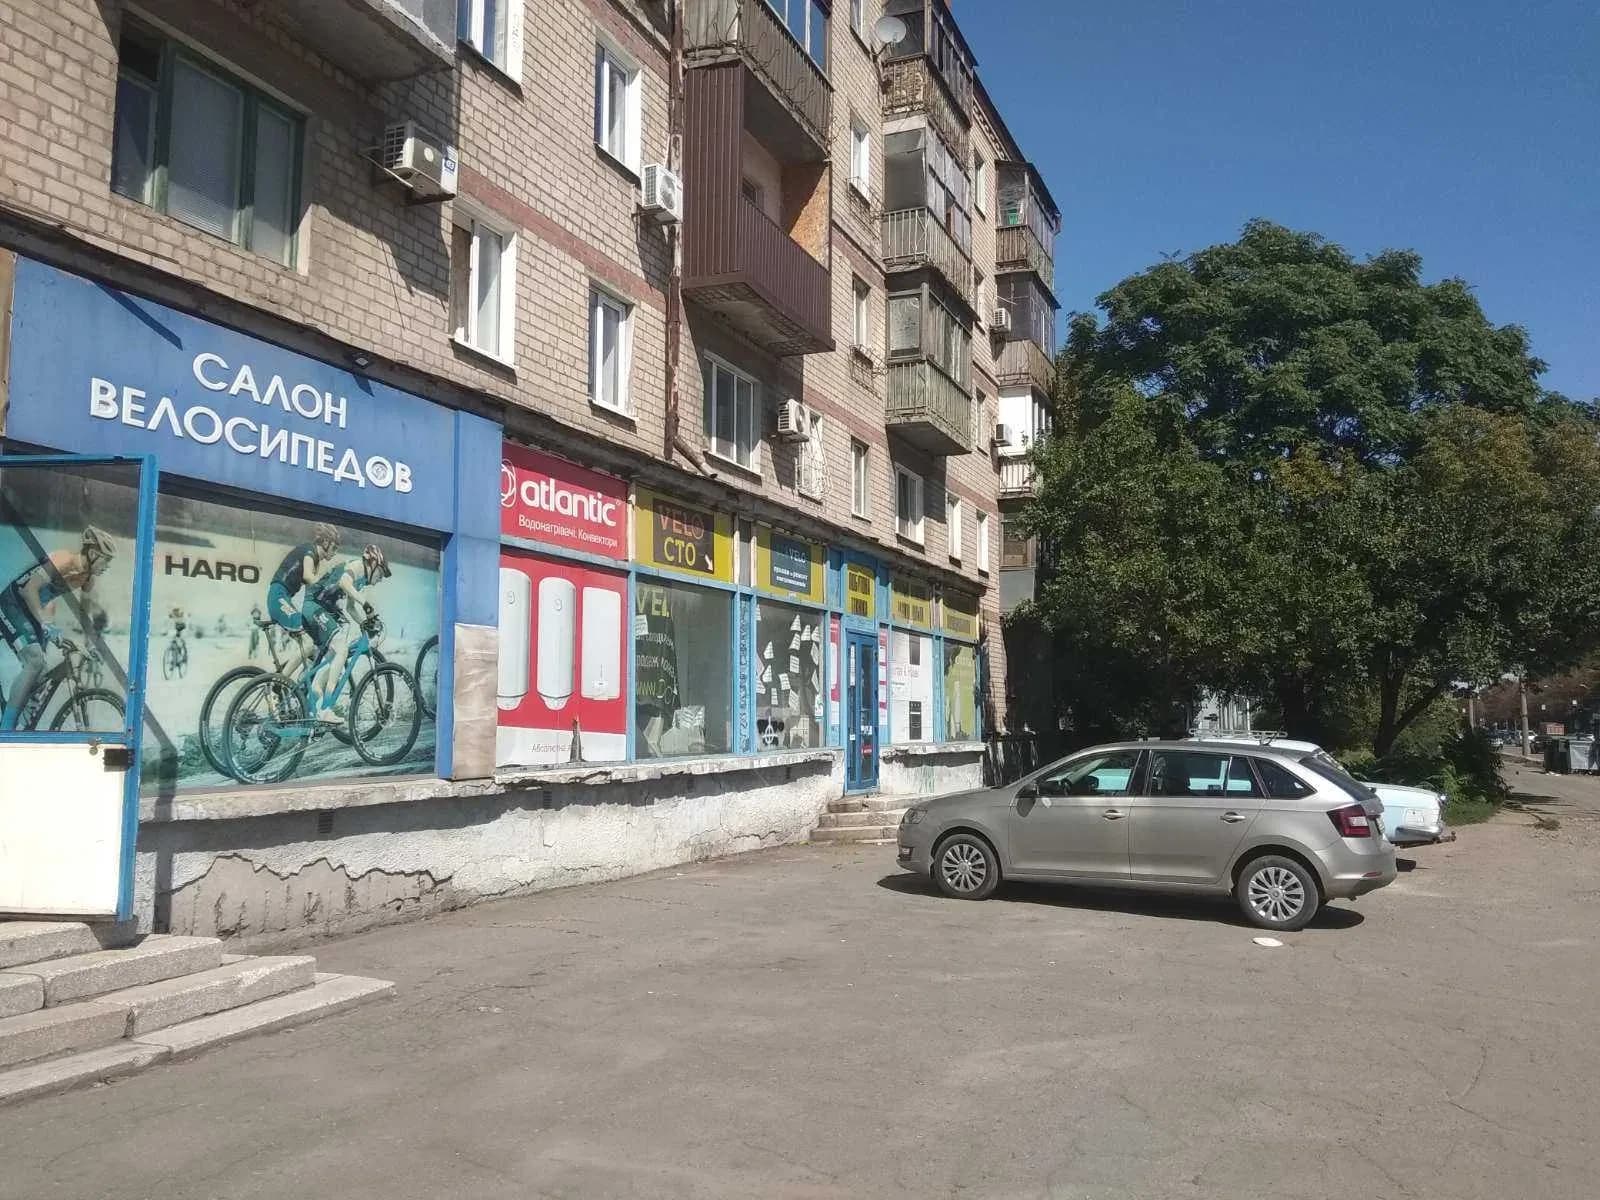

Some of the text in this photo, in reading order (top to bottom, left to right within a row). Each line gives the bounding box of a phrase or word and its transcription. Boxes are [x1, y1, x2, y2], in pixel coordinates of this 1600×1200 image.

[192, 352, 347, 428] САЛОН
[90, 377, 413, 493] ВЕЛОСИПЕДОВ
[520, 478, 617, 527] atlantic
[659, 505, 705, 540] VELO
[164, 555, 260, 585] HARO
